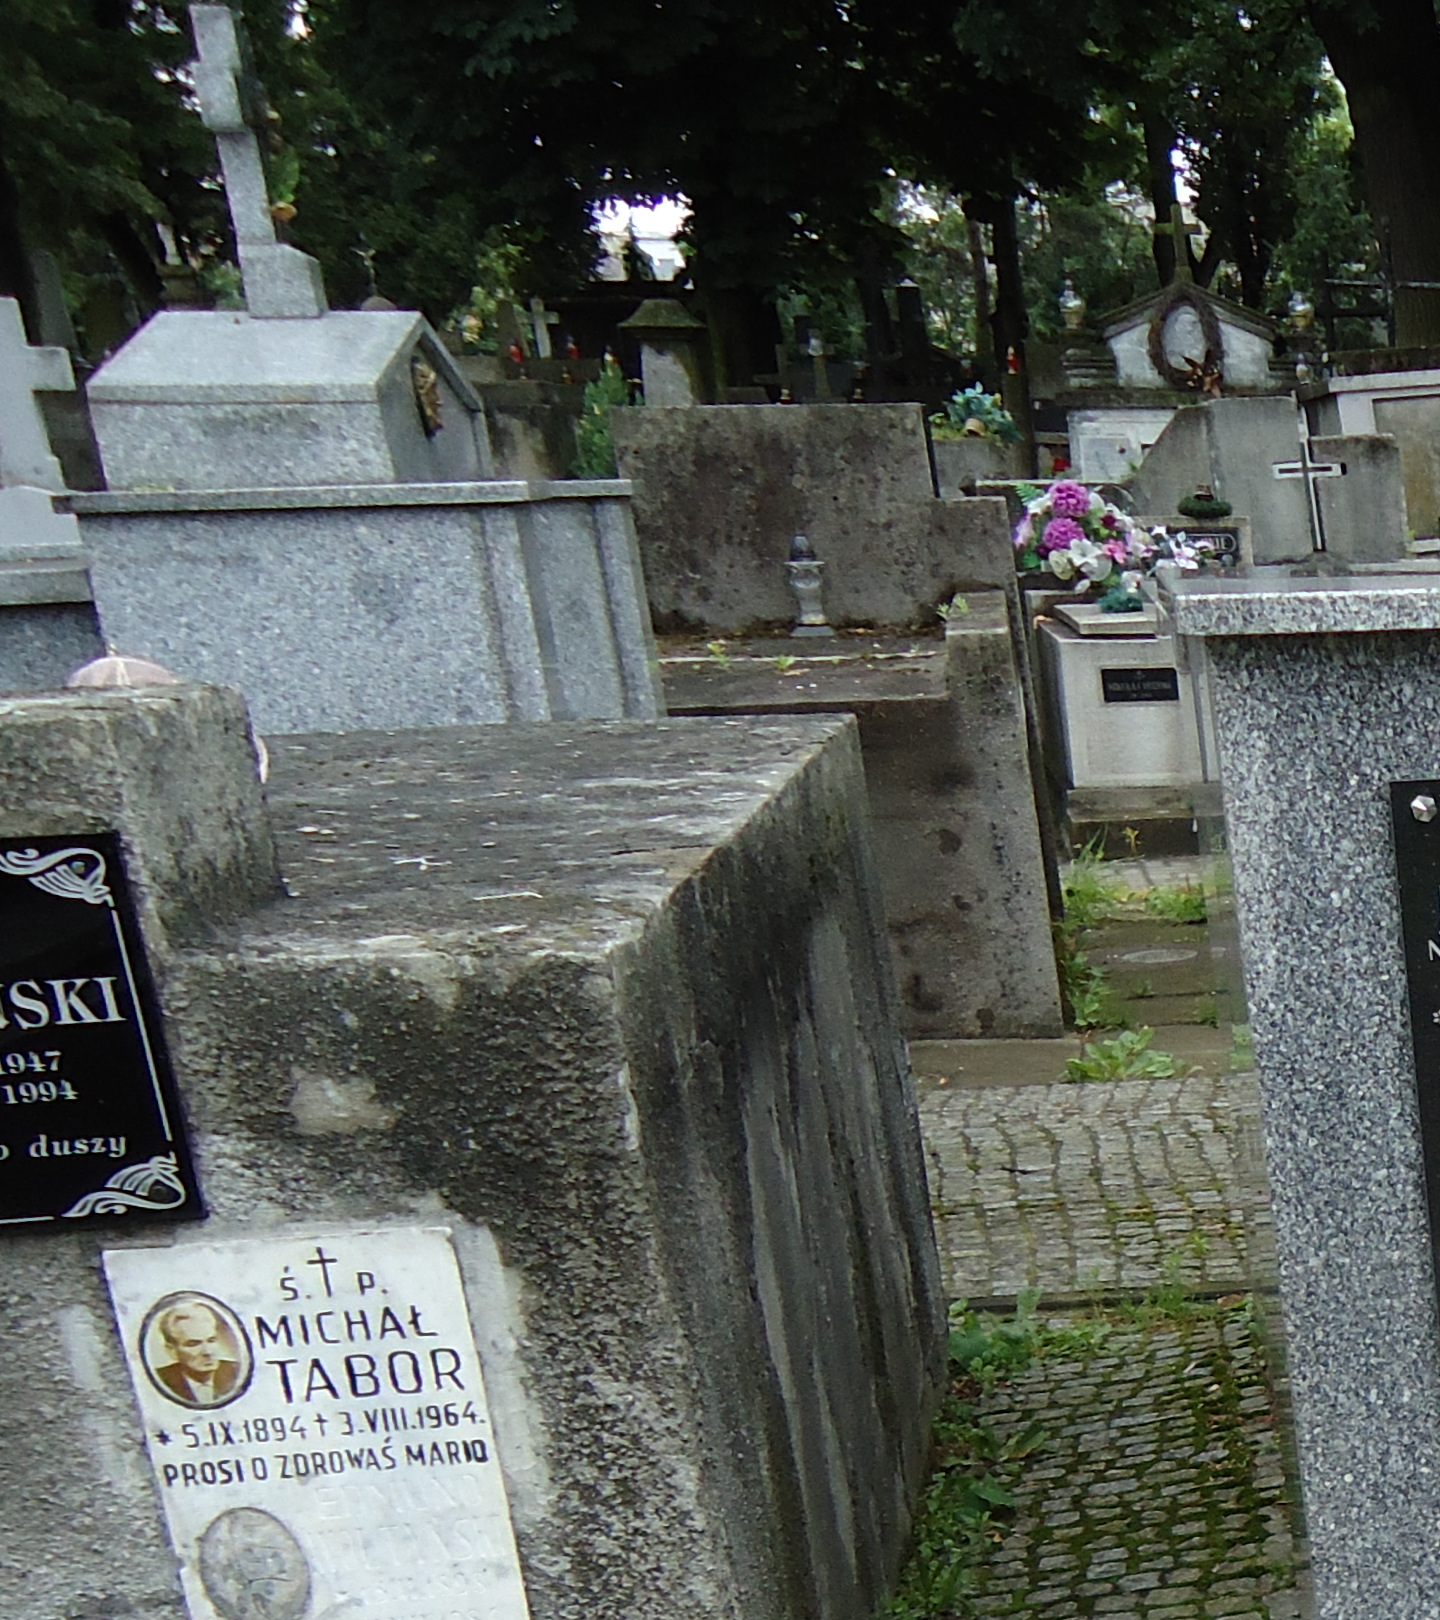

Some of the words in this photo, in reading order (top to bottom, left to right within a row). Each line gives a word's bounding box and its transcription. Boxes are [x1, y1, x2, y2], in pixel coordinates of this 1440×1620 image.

[0, 976, 128, 1030] SKI
[29, 1134, 127, 1158] duszy
[255, 1305, 439, 1349] MICHAŁ
[265, 1348, 466, 1403] TABOR
[182, 1415, 307, 1449] 5.IX.1894
[162, 1460, 244, 1487] PROSI
[252, 1457, 269, 1480] O
[274, 1437, 396, 1479] ZDROWAŚ
